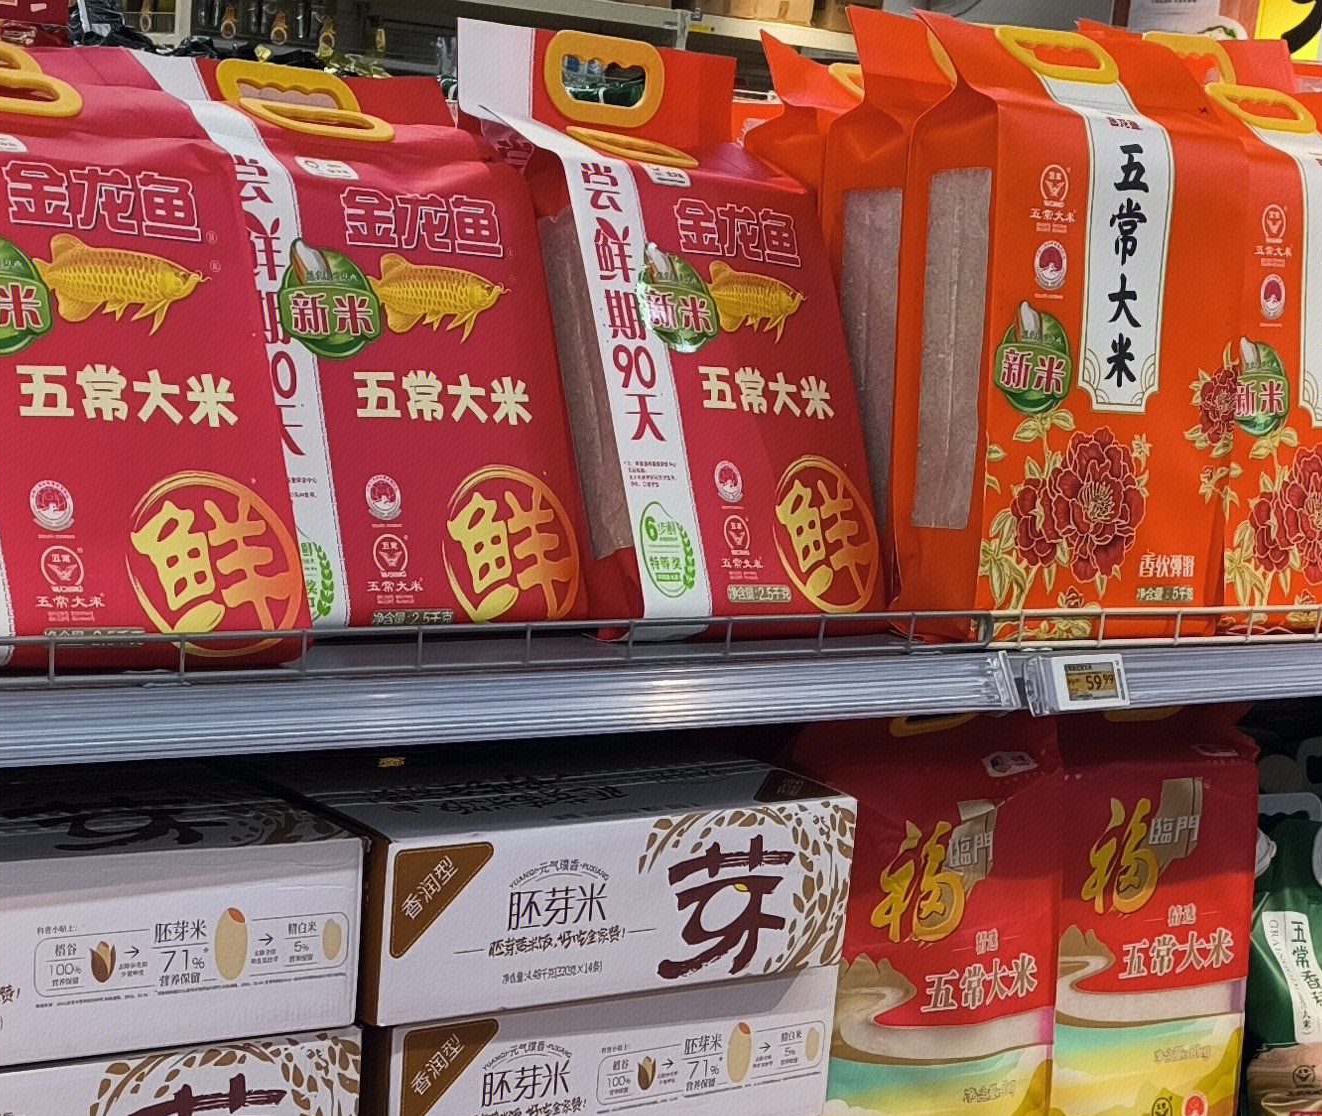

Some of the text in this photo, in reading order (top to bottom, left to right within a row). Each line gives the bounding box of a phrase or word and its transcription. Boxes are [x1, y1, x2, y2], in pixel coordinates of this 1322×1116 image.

[1, 159, 204, 242] 金龙鱼
[341, 186, 505, 257] 金龙鱼
[674, 198, 802, 266] 金龙鱼
[1105, 144, 1149, 388] 五常大米
[291, 292, 372, 336] 新米
[580, 163, 667, 444] 尝鲜期90天
[15, 364, 238, 428] 五常大米
[353, 370, 532, 425] 五常大米
[697, 365, 835, 421] 五常大米
[1001, 348, 1066, 392] 新米
[1233, 381, 1285, 415] 新米
[131, 500, 286, 633] 鲜
[447, 490, 563, 623] 鲜
[775, 487, 874, 601] 鲜
[870, 819, 965, 943] 福
[1081, 797, 1159, 914] 福
[401, 855, 459, 922] 香润型
[507, 884, 607, 931] 胚芽米
[656, 835, 796, 979] 芽
[153, 920, 207, 944] 胚芽米
[1118, 930, 1234, 981] 五常大米
[921, 954, 1038, 1014] 五常大米
[411, 1033, 465, 1096] 香润型
[684, 1034, 723, 1055] 胚芽米
[482, 1059, 570, 1108] 胚芽米
